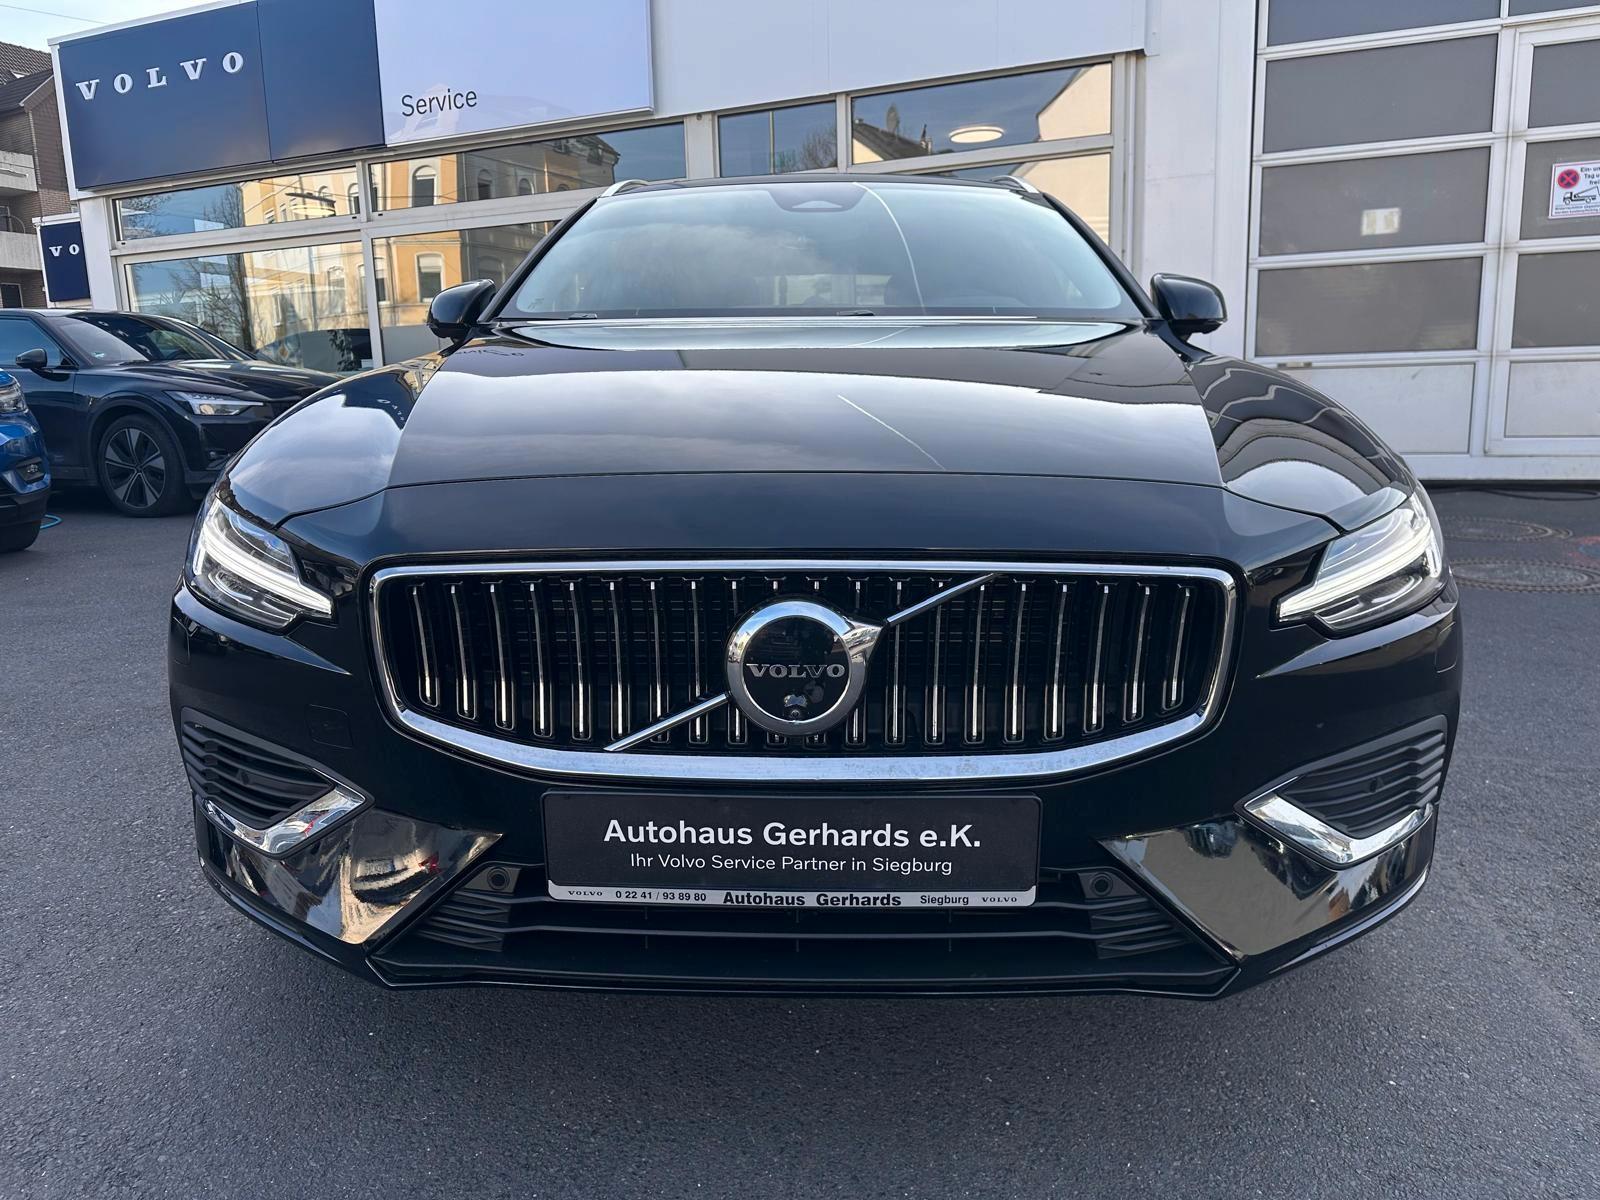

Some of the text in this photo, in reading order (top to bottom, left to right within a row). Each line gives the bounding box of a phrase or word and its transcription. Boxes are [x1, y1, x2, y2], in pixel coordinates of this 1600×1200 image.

[76, 52, 244, 101] VOLVO
[401, 88, 478, 117] Service
[746, 663, 846, 678] VOLVO
[603, 819, 981, 848] Autohaus Gerhards e.K.
[630, 853, 952, 876] Ihr Volvo Service Partner in Siegburg
[615, 890, 622, 899] 0
[625, 890, 638, 899] 22
[640, 890, 652, 900] 41
[662, 892, 675, 901] 93
[678, 892, 691, 901] 89
[693, 893, 707, 902] 80
[723, 892, 901, 906] Autohaus Gerhards
[920, 895, 969, 905] Siegburg
